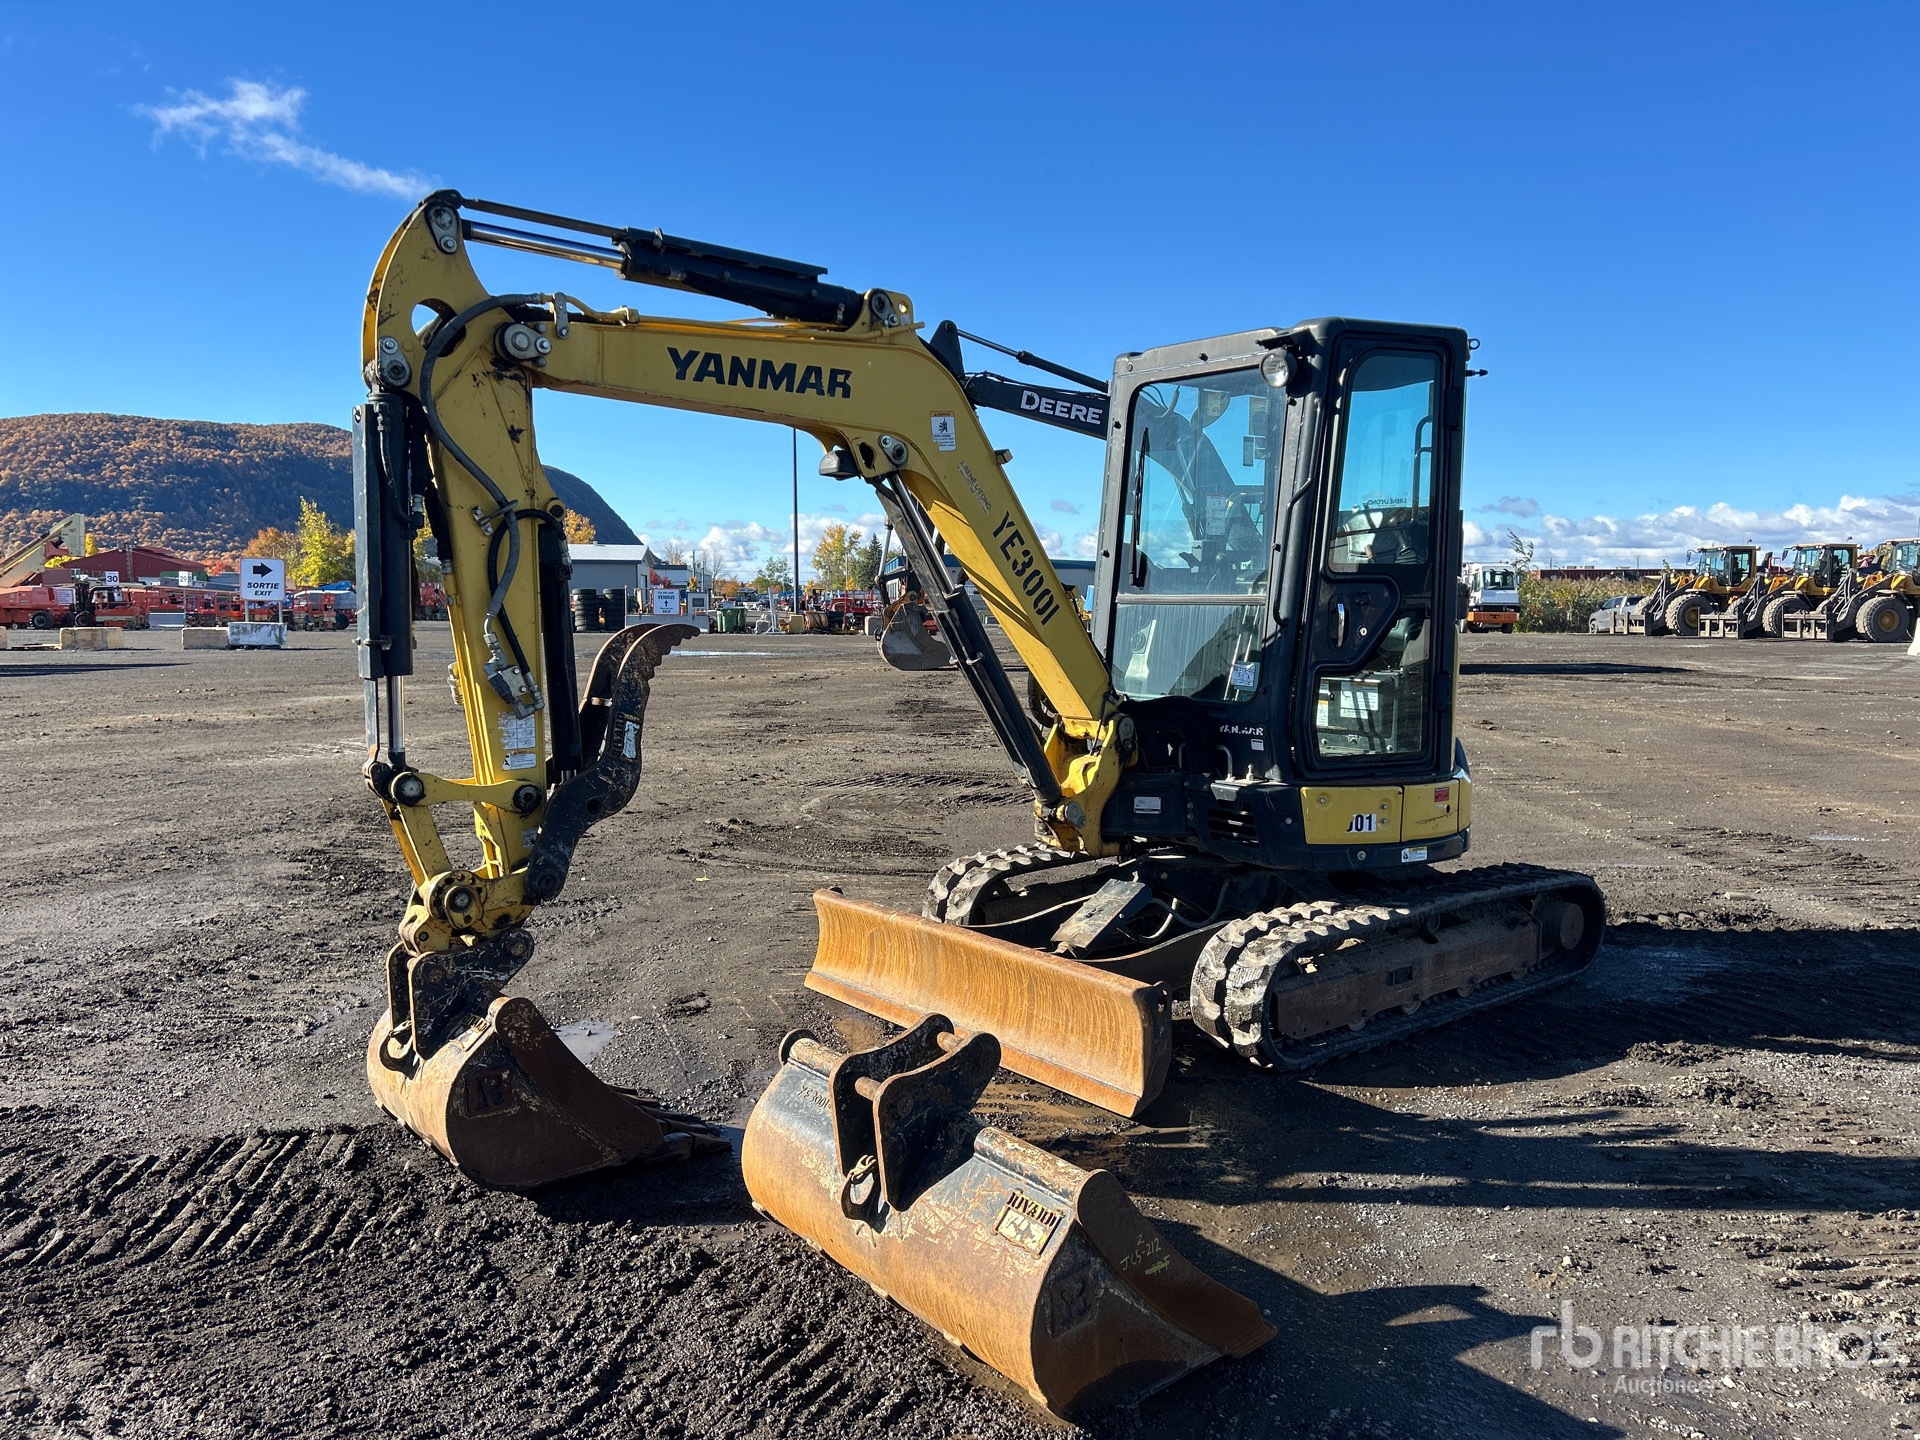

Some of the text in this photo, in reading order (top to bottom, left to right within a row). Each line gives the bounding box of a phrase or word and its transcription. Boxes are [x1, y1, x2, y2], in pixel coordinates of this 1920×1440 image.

[667, 347, 852, 398] YANMAR
[1020, 390, 1103, 425] DEERE
[1137, 1233, 1145, 1246] 2
